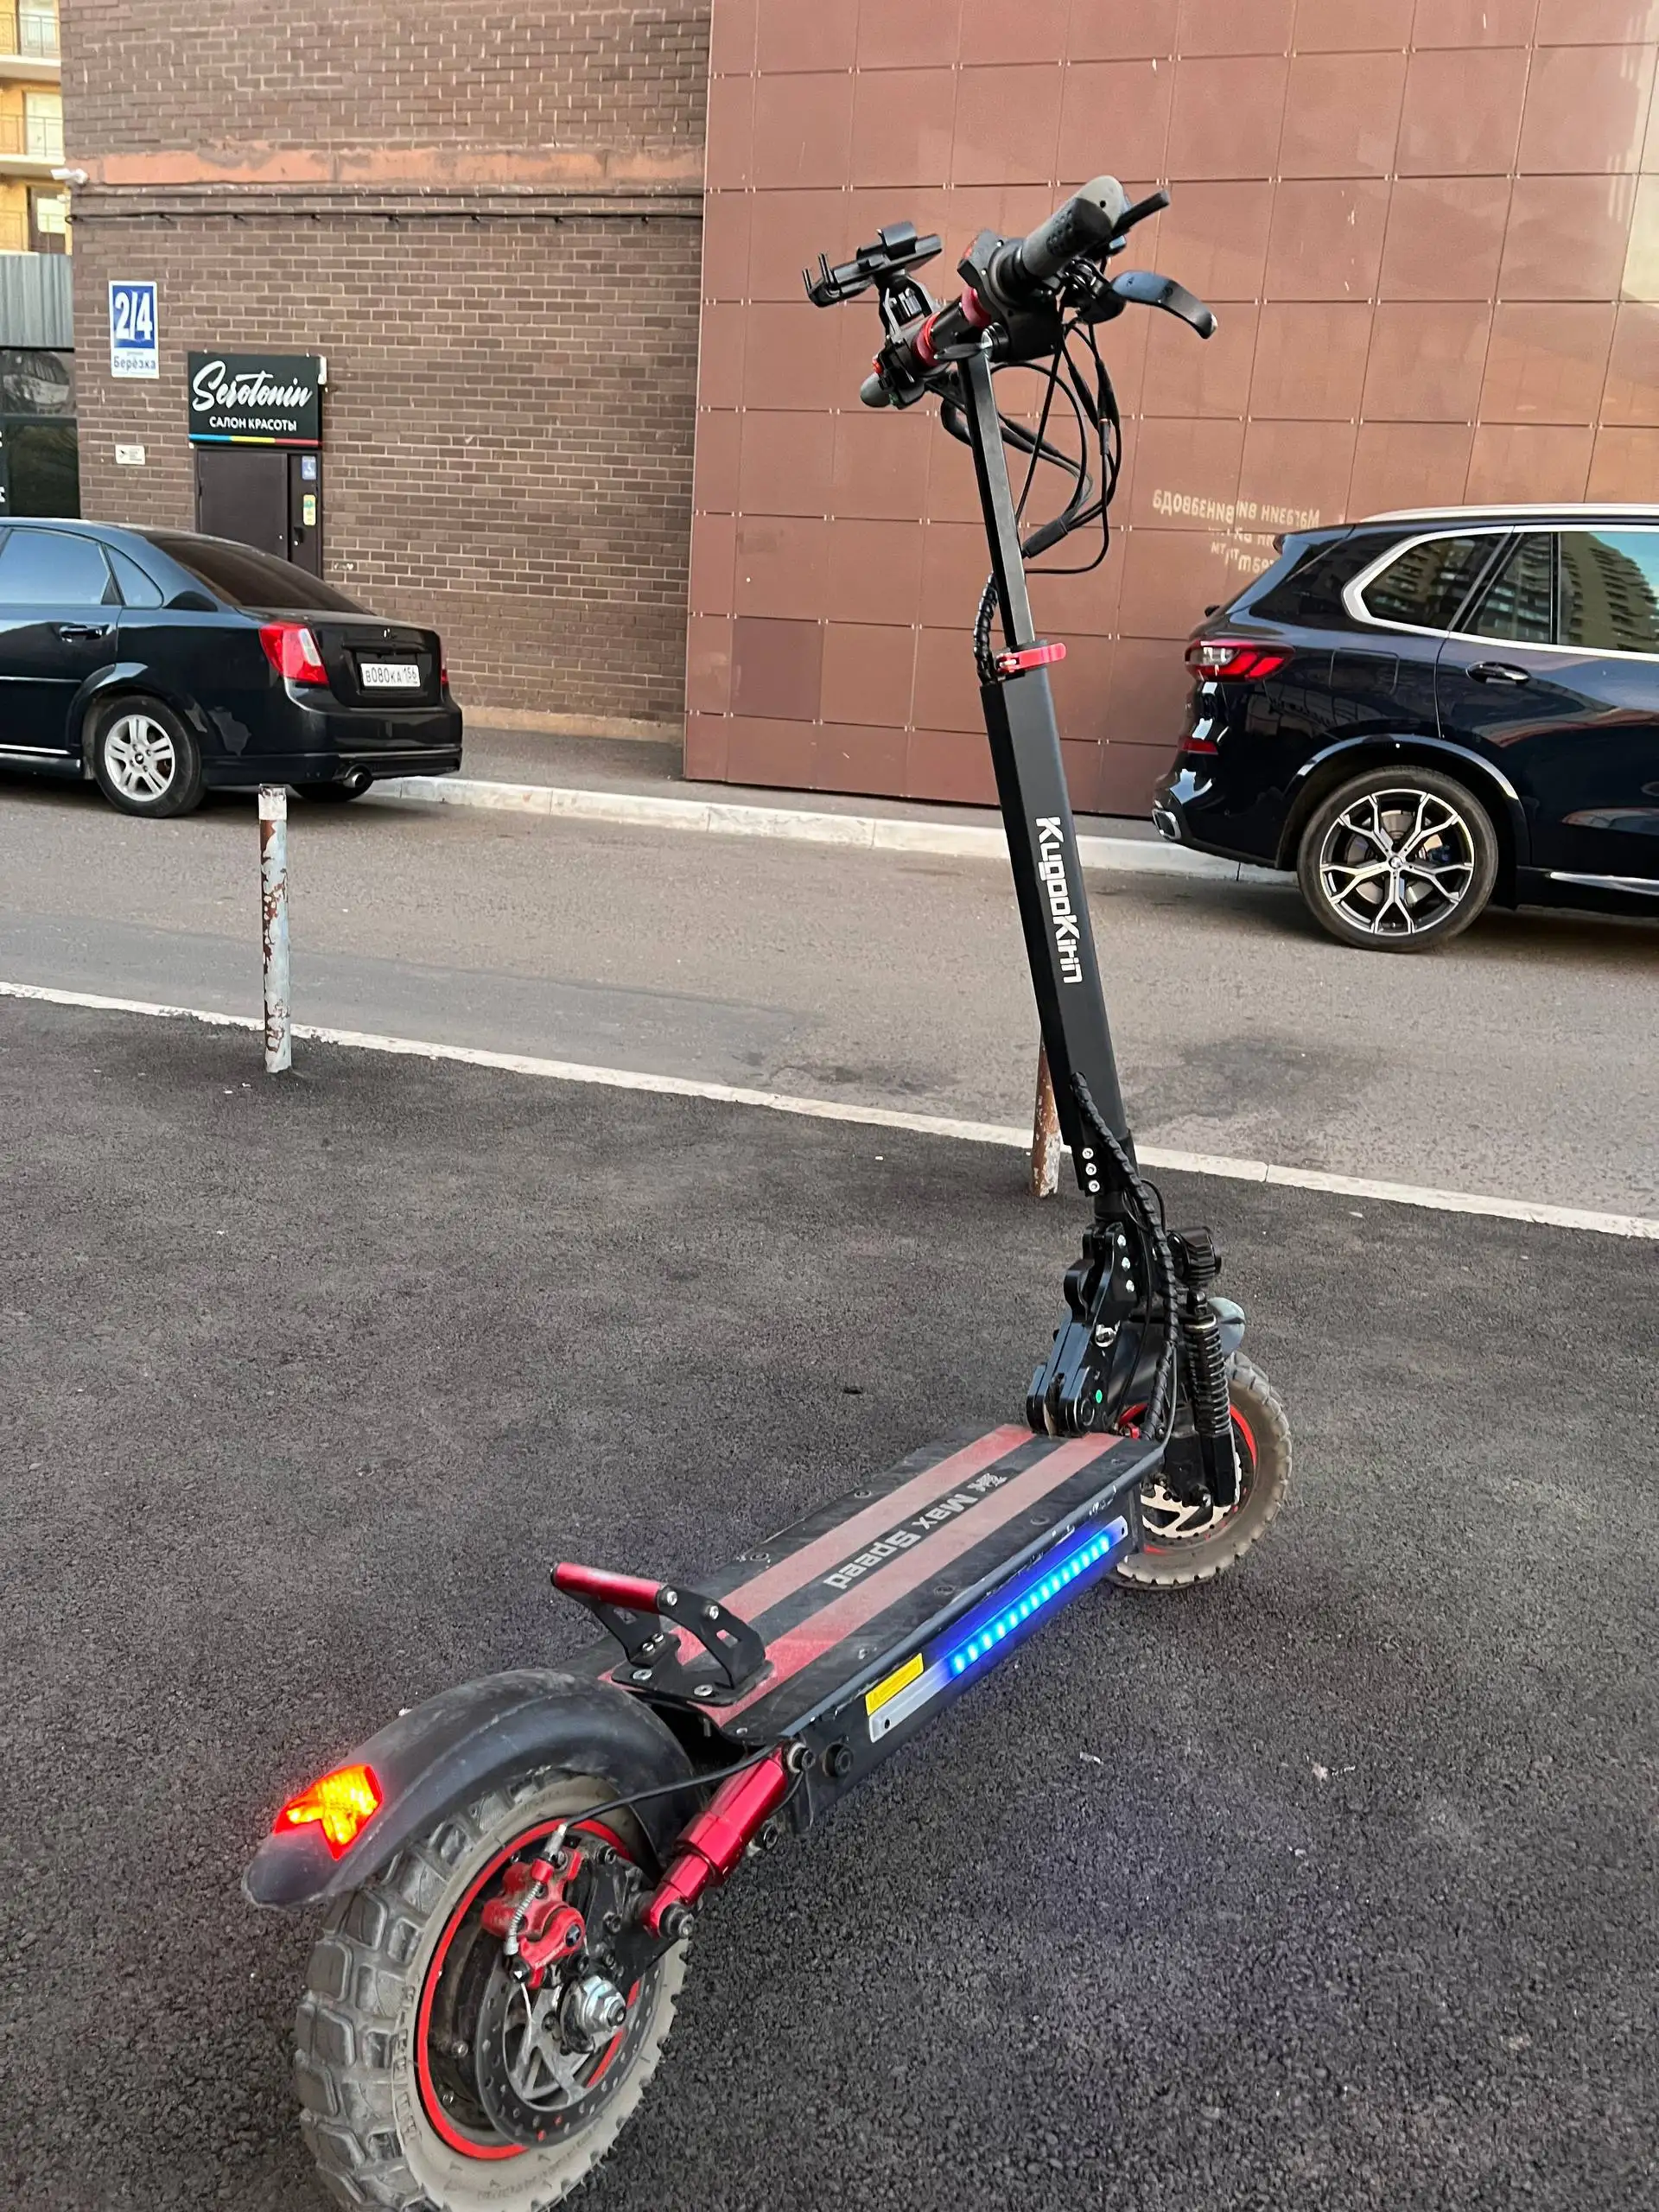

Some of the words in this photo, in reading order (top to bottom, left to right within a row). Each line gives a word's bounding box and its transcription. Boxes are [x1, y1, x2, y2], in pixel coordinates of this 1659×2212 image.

[114, 291, 153, 340] 2/4
[192, 360, 313, 411] Serotonin
[209, 416, 246, 429] САЛОН
[248, 418, 297, 431] КРАСОТЫ
[1036, 817, 1083, 983] KugooKirin
[911, 1493, 978, 1529] Max
[823, 1530, 921, 1590] Speed
